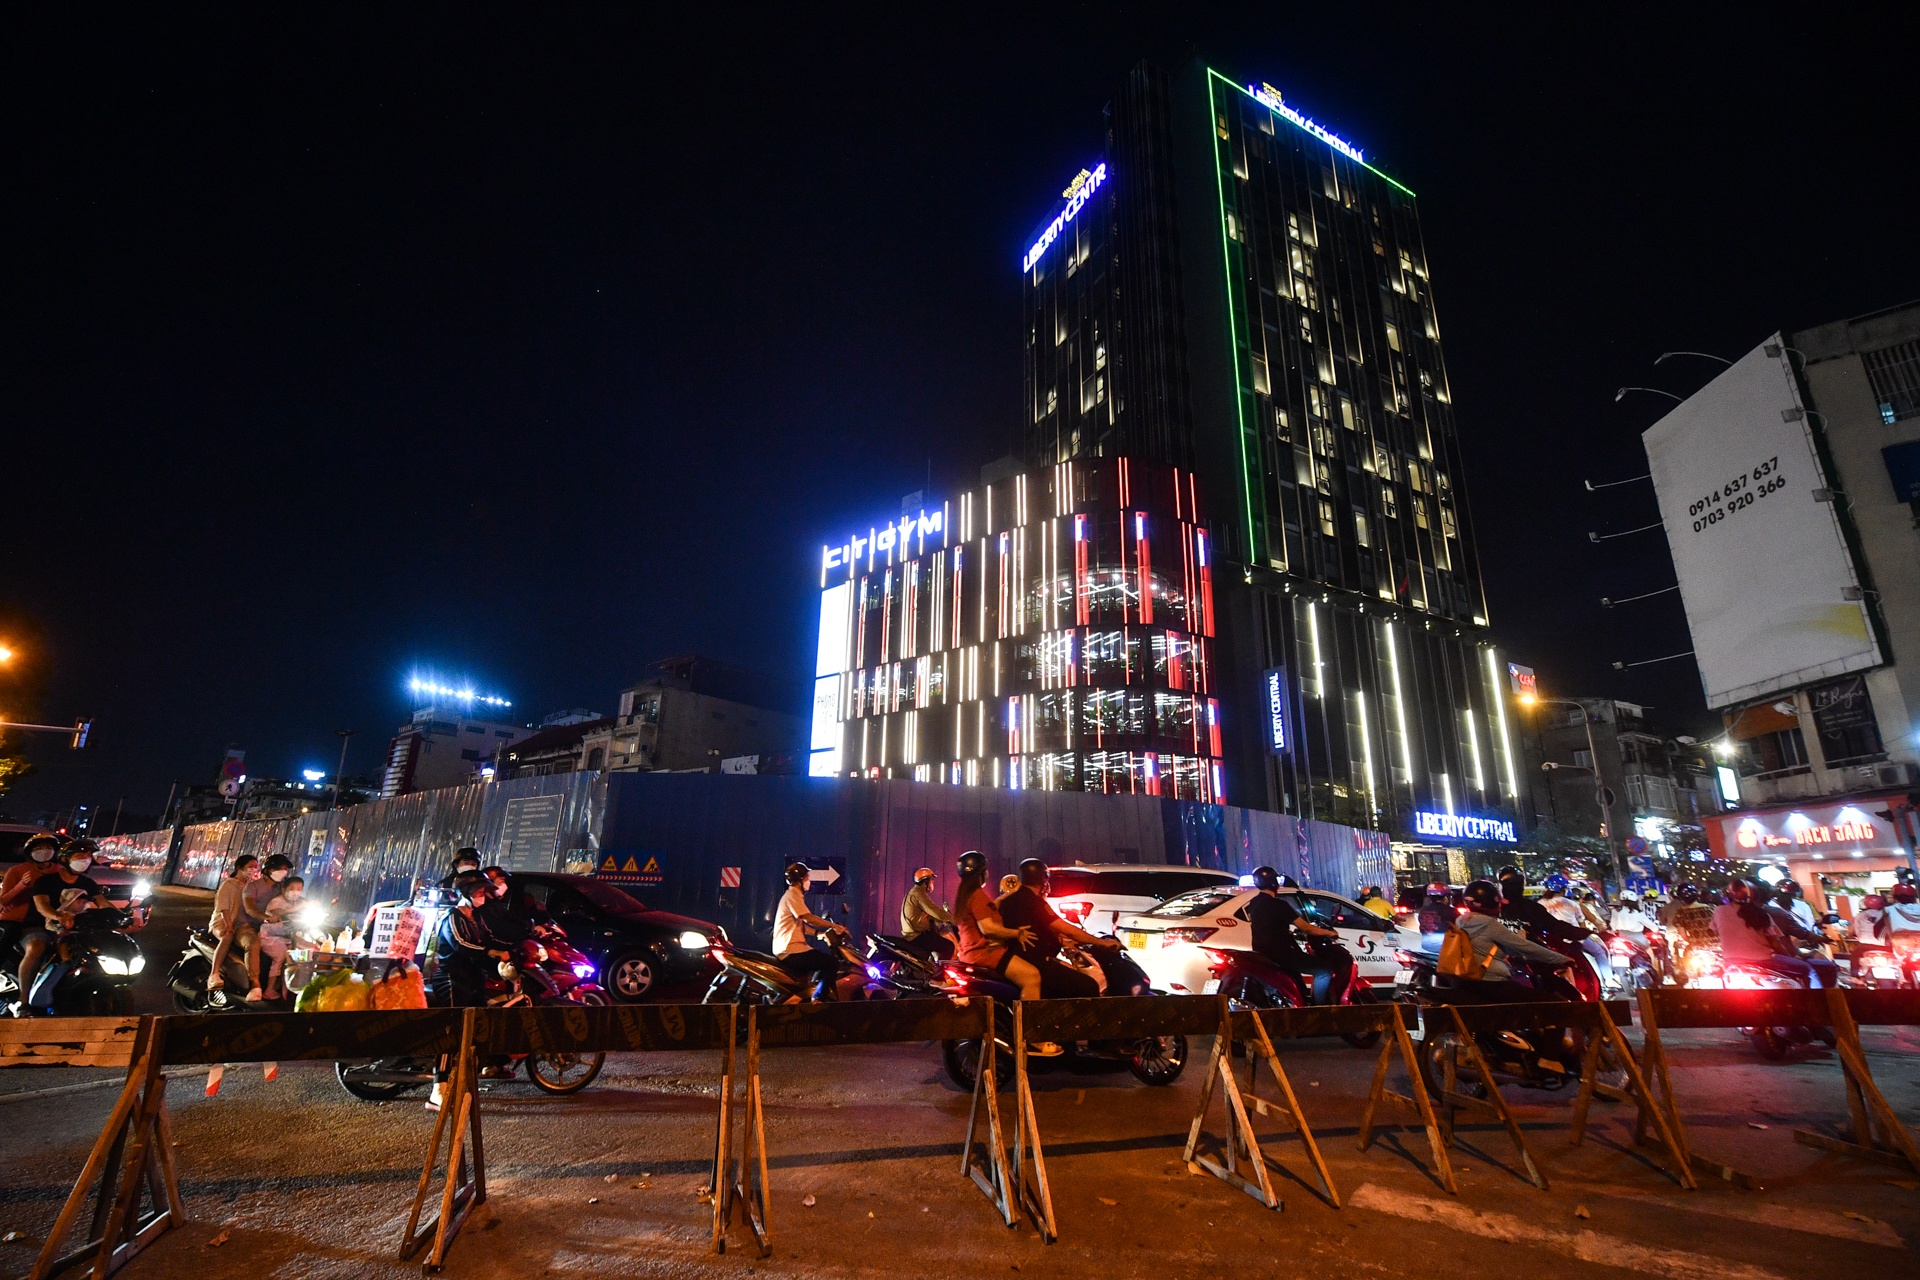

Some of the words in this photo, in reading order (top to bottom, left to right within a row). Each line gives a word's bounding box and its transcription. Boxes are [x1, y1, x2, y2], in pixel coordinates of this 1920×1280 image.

[1023, 209, 1065, 273] LIBERTY
[1688, 490, 1721, 517] 0914
[1723, 474, 1748, 497] 637
[1753, 456, 1778, 481] 637
[1693, 508, 1725, 533] 0703
[1727, 492, 1754, 514] 920
[1757, 474, 1786, 498] 366
[824, 507, 943, 569] CITIGYM
[1269, 672, 1281, 714] CENTRAL
[1272, 714, 1284, 749] LIBERTY
[1415, 811, 1464, 837] LIBERTY
[1464, 815, 1518, 842] CENTRAL
